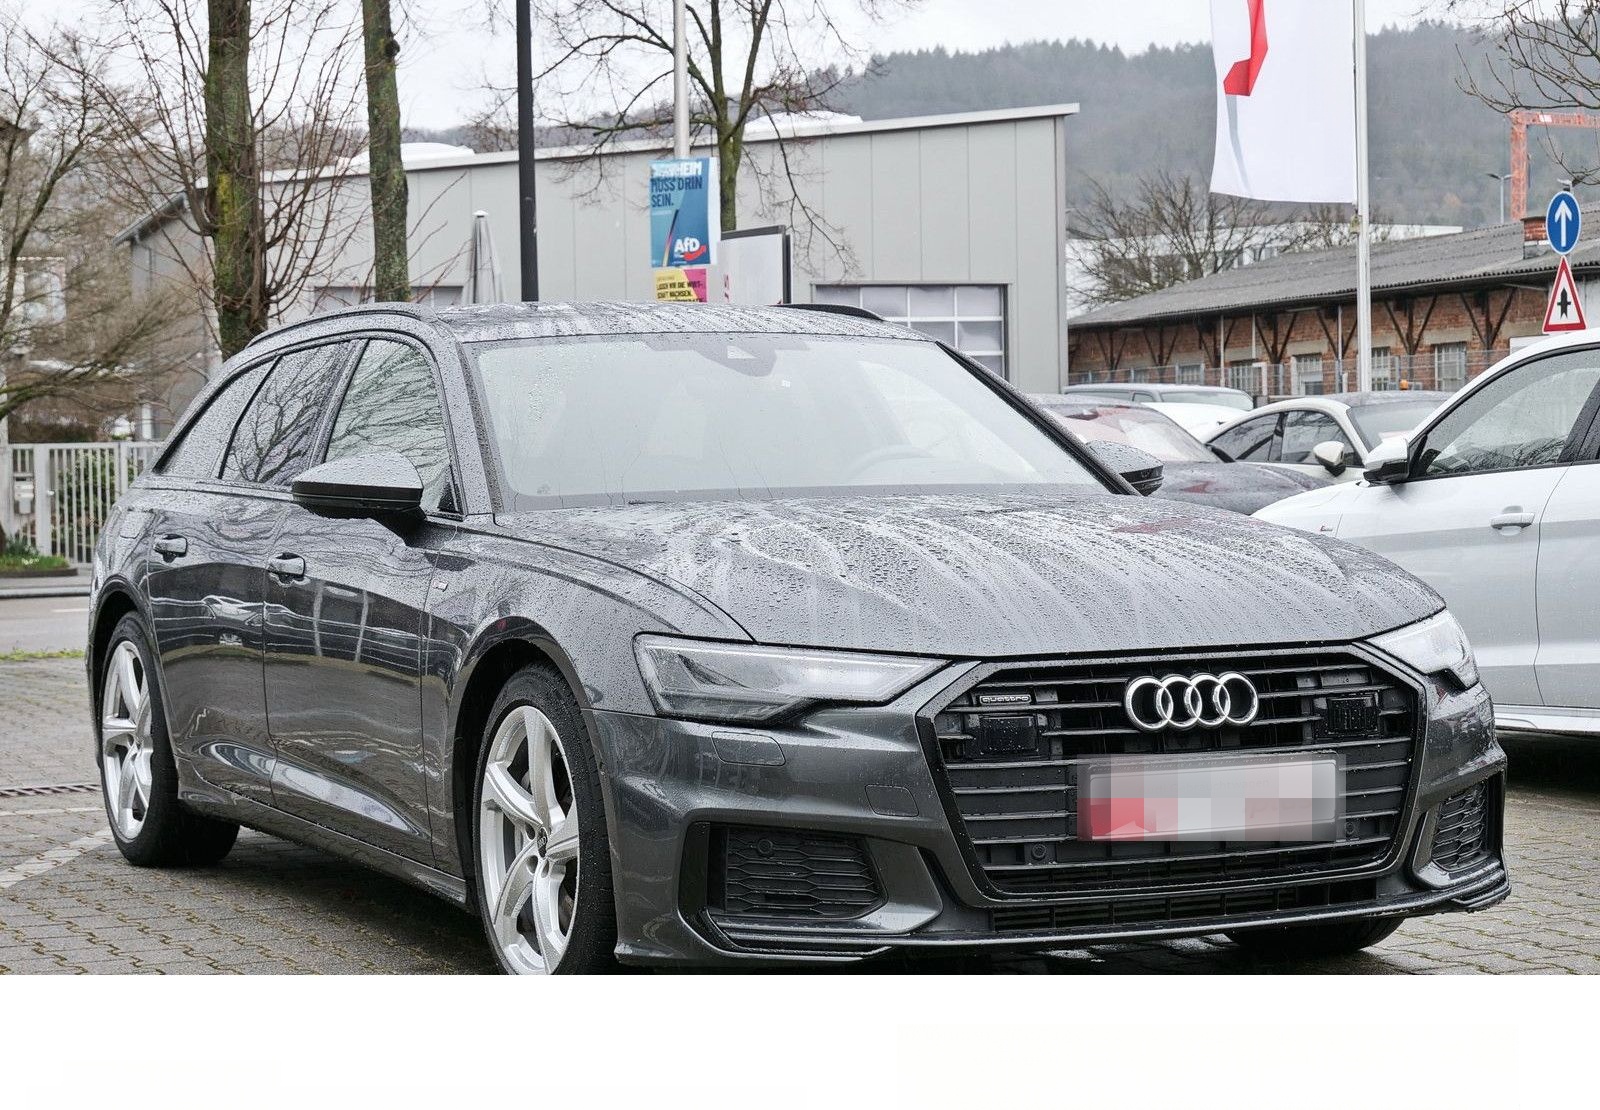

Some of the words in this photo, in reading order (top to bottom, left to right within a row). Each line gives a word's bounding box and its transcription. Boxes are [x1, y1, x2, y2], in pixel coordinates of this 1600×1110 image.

[677, 176, 703, 190] DRIN
[651, 193, 675, 208] SEIN.
[674, 237, 701, 253] AfD
[982, 696, 1030, 704] quattro
